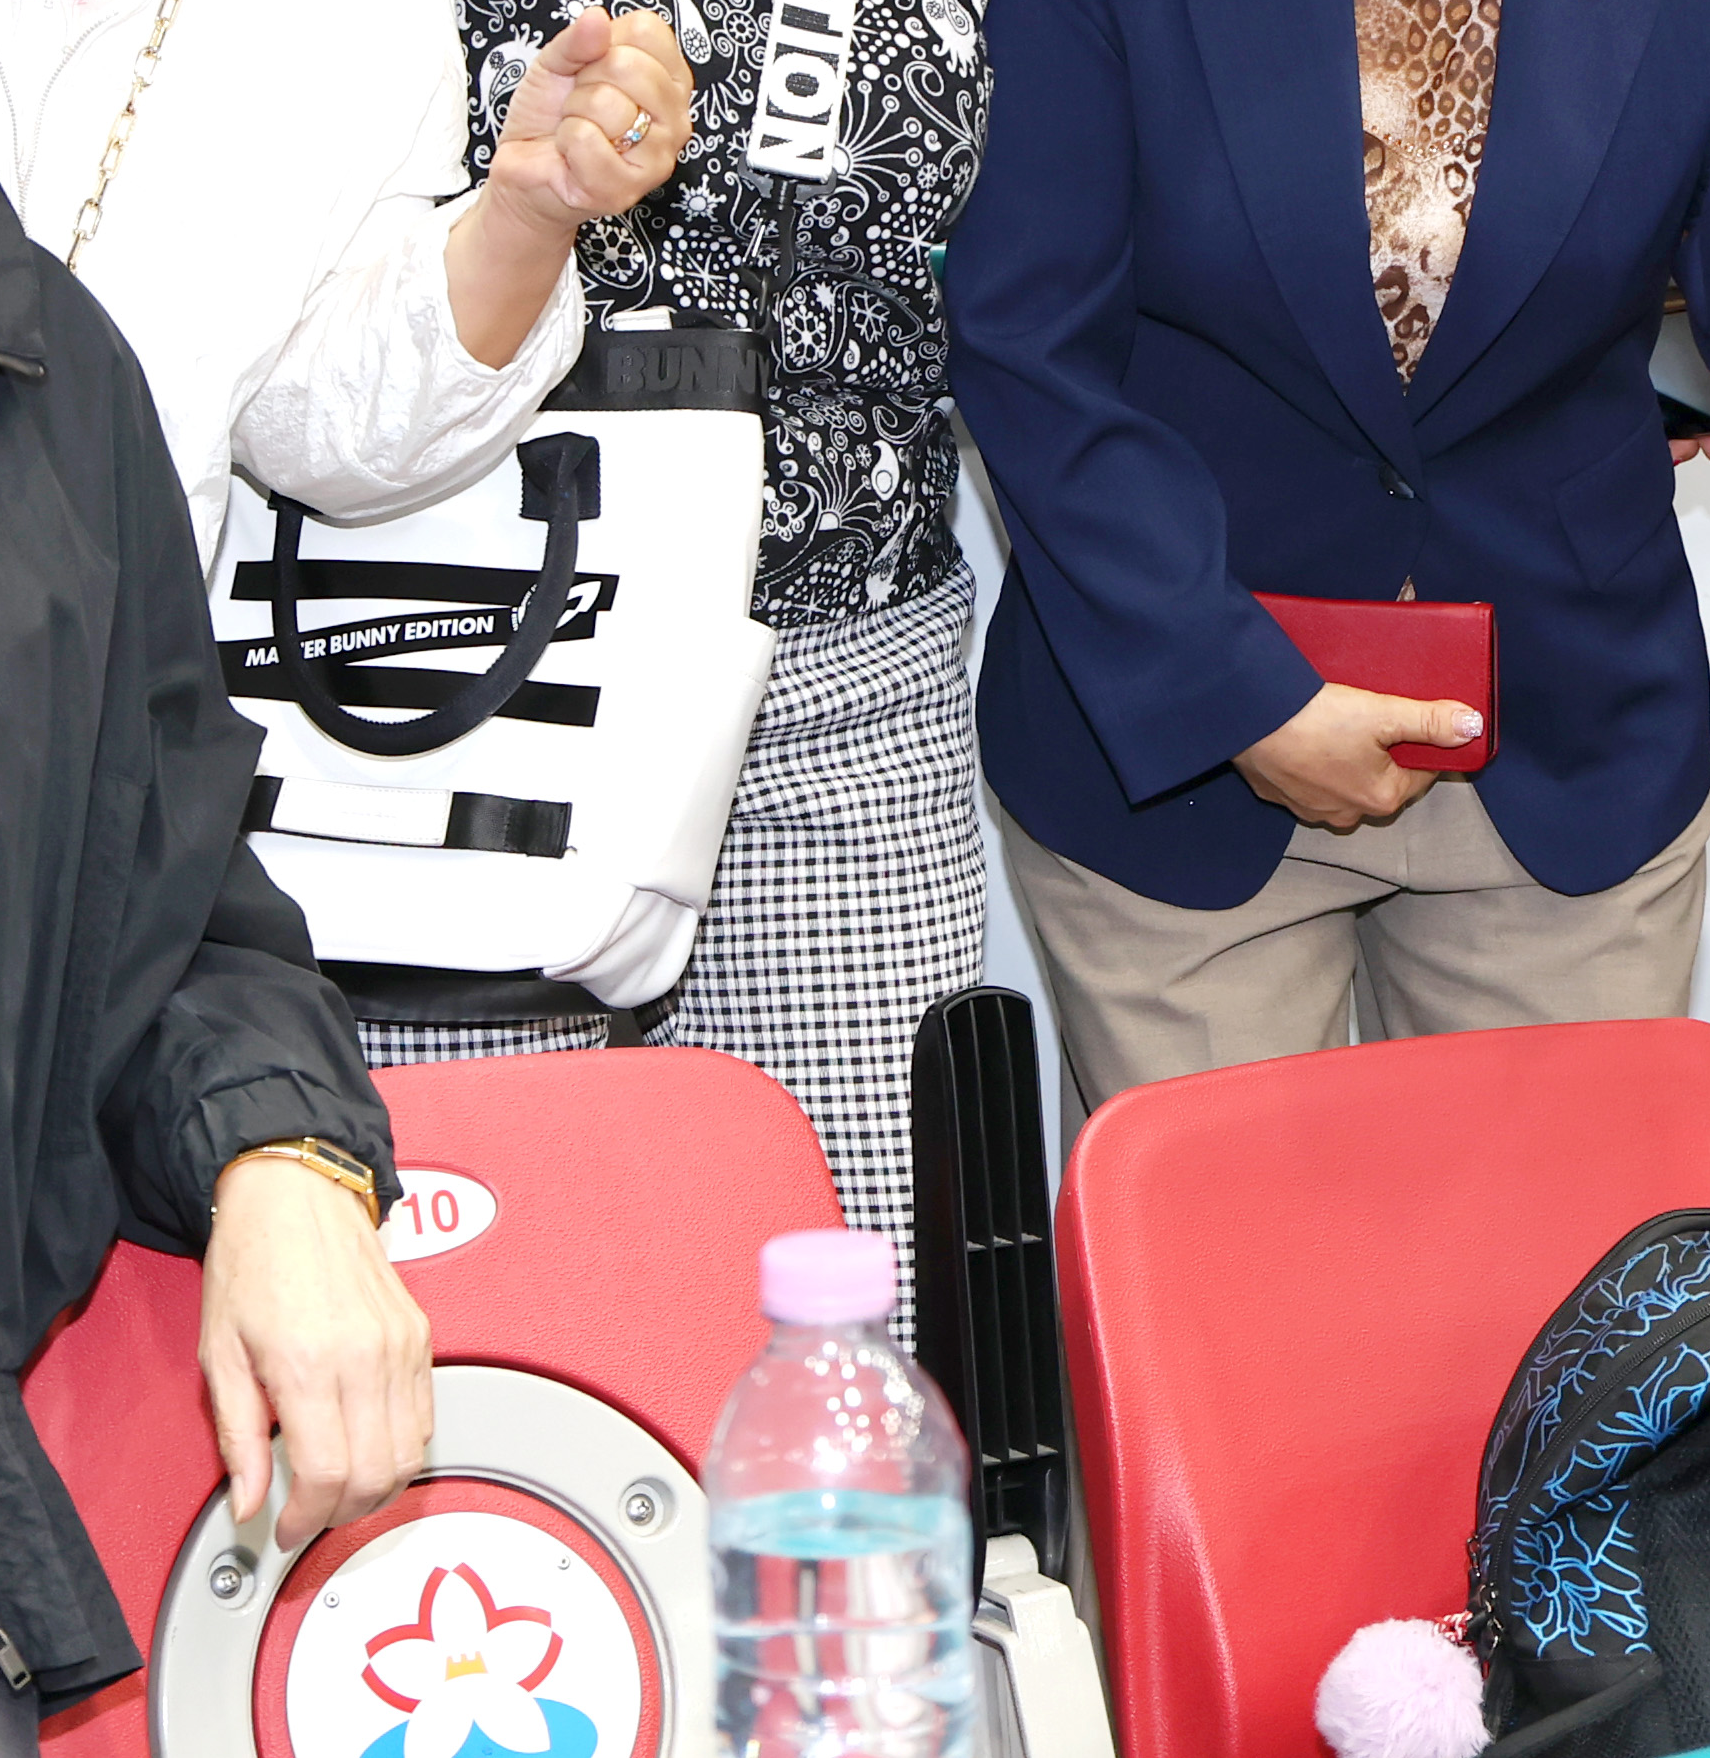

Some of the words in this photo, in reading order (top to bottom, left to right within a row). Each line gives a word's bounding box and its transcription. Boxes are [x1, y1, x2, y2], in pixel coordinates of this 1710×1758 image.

[244, 637, 327, 668] MAER
[329, 623, 402, 655] BUNNY
[403, 615, 495, 641] EDITION
[401, 1189, 460, 1236] 10
